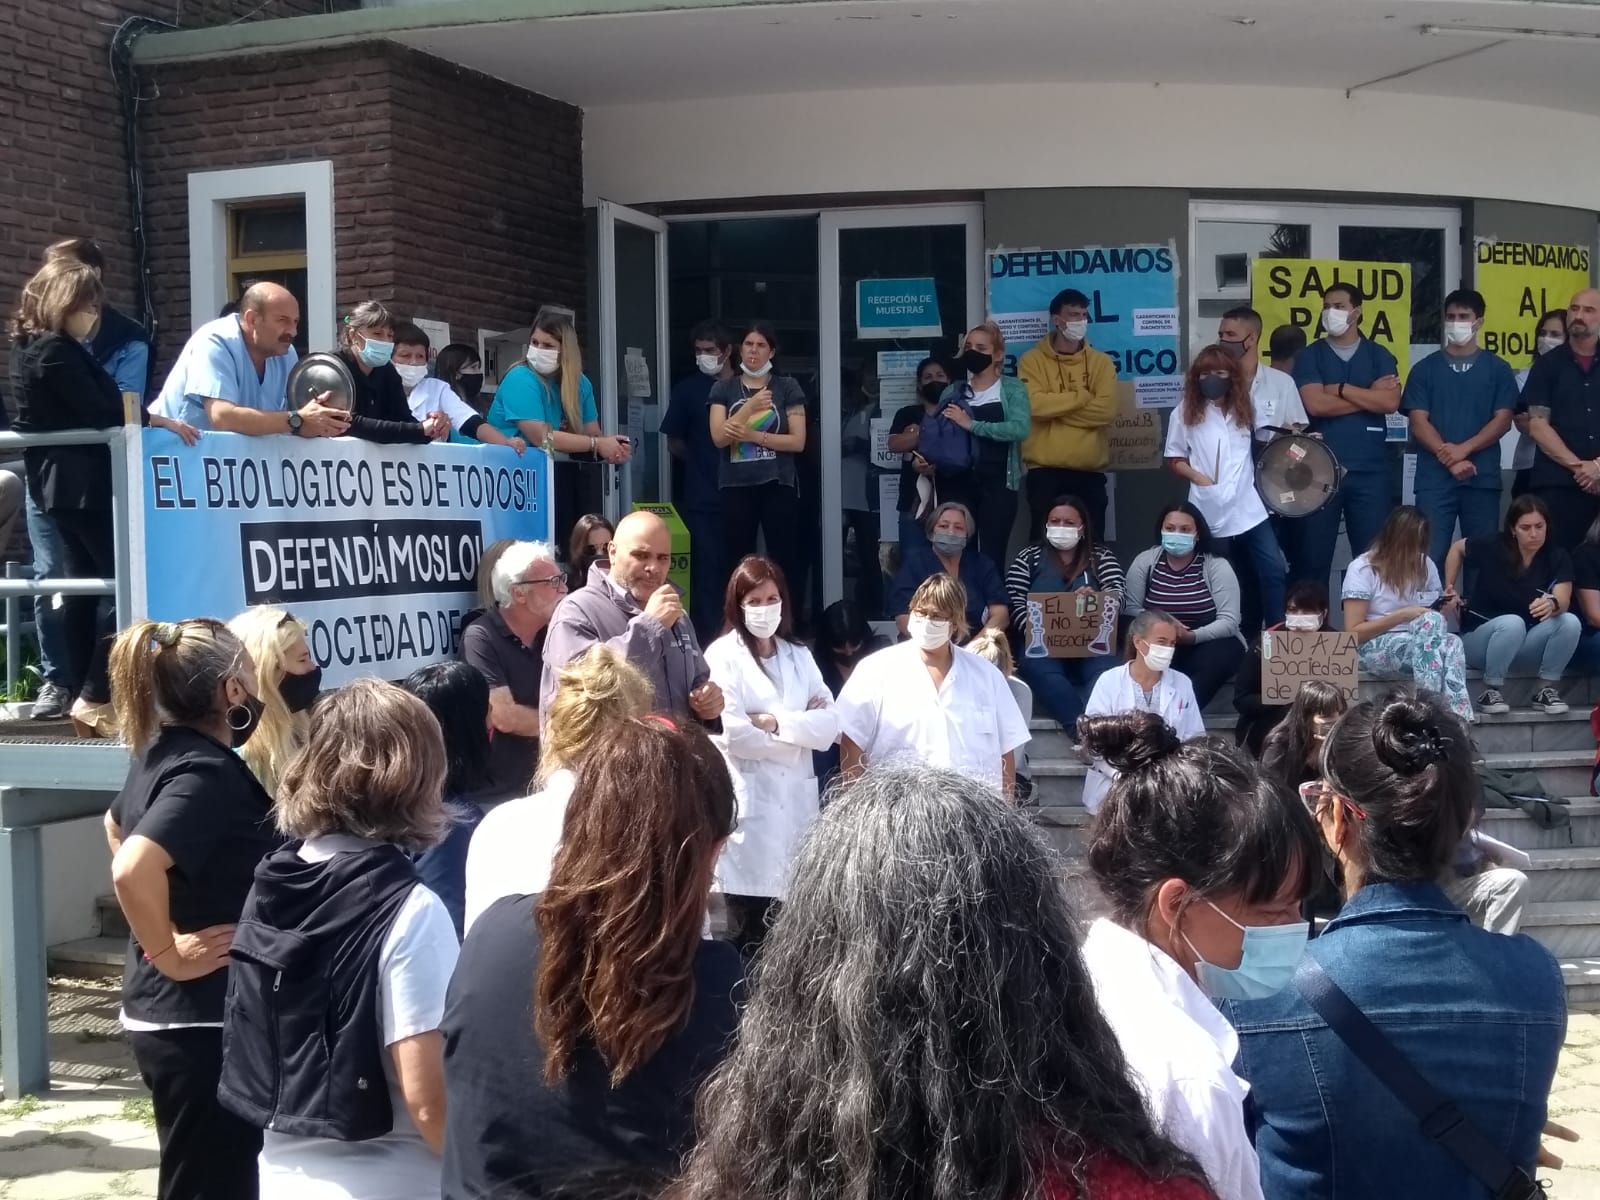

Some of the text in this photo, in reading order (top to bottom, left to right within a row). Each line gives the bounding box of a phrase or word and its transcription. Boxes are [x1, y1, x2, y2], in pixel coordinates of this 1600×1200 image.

[990, 248, 1172, 277] DEFENDAMOS
[1478, 241, 1588, 271] DEFENDAMOS
[867, 293, 933, 305] RECEPCIÓN DE
[876, 305, 924, 315] MUESTRAS
[151, 456, 538, 512] EL BIOLOGICO ES DE TODOS!!
[1045, 595, 1065, 614] EL
[1050, 615, 1099, 630] NO SE
[311, 611, 434, 669] OCIEDAD
[1276, 631, 1359, 656] NO A LA
[1269, 655, 1355, 676] Sociedad
[1266, 678, 1292, 700] de
